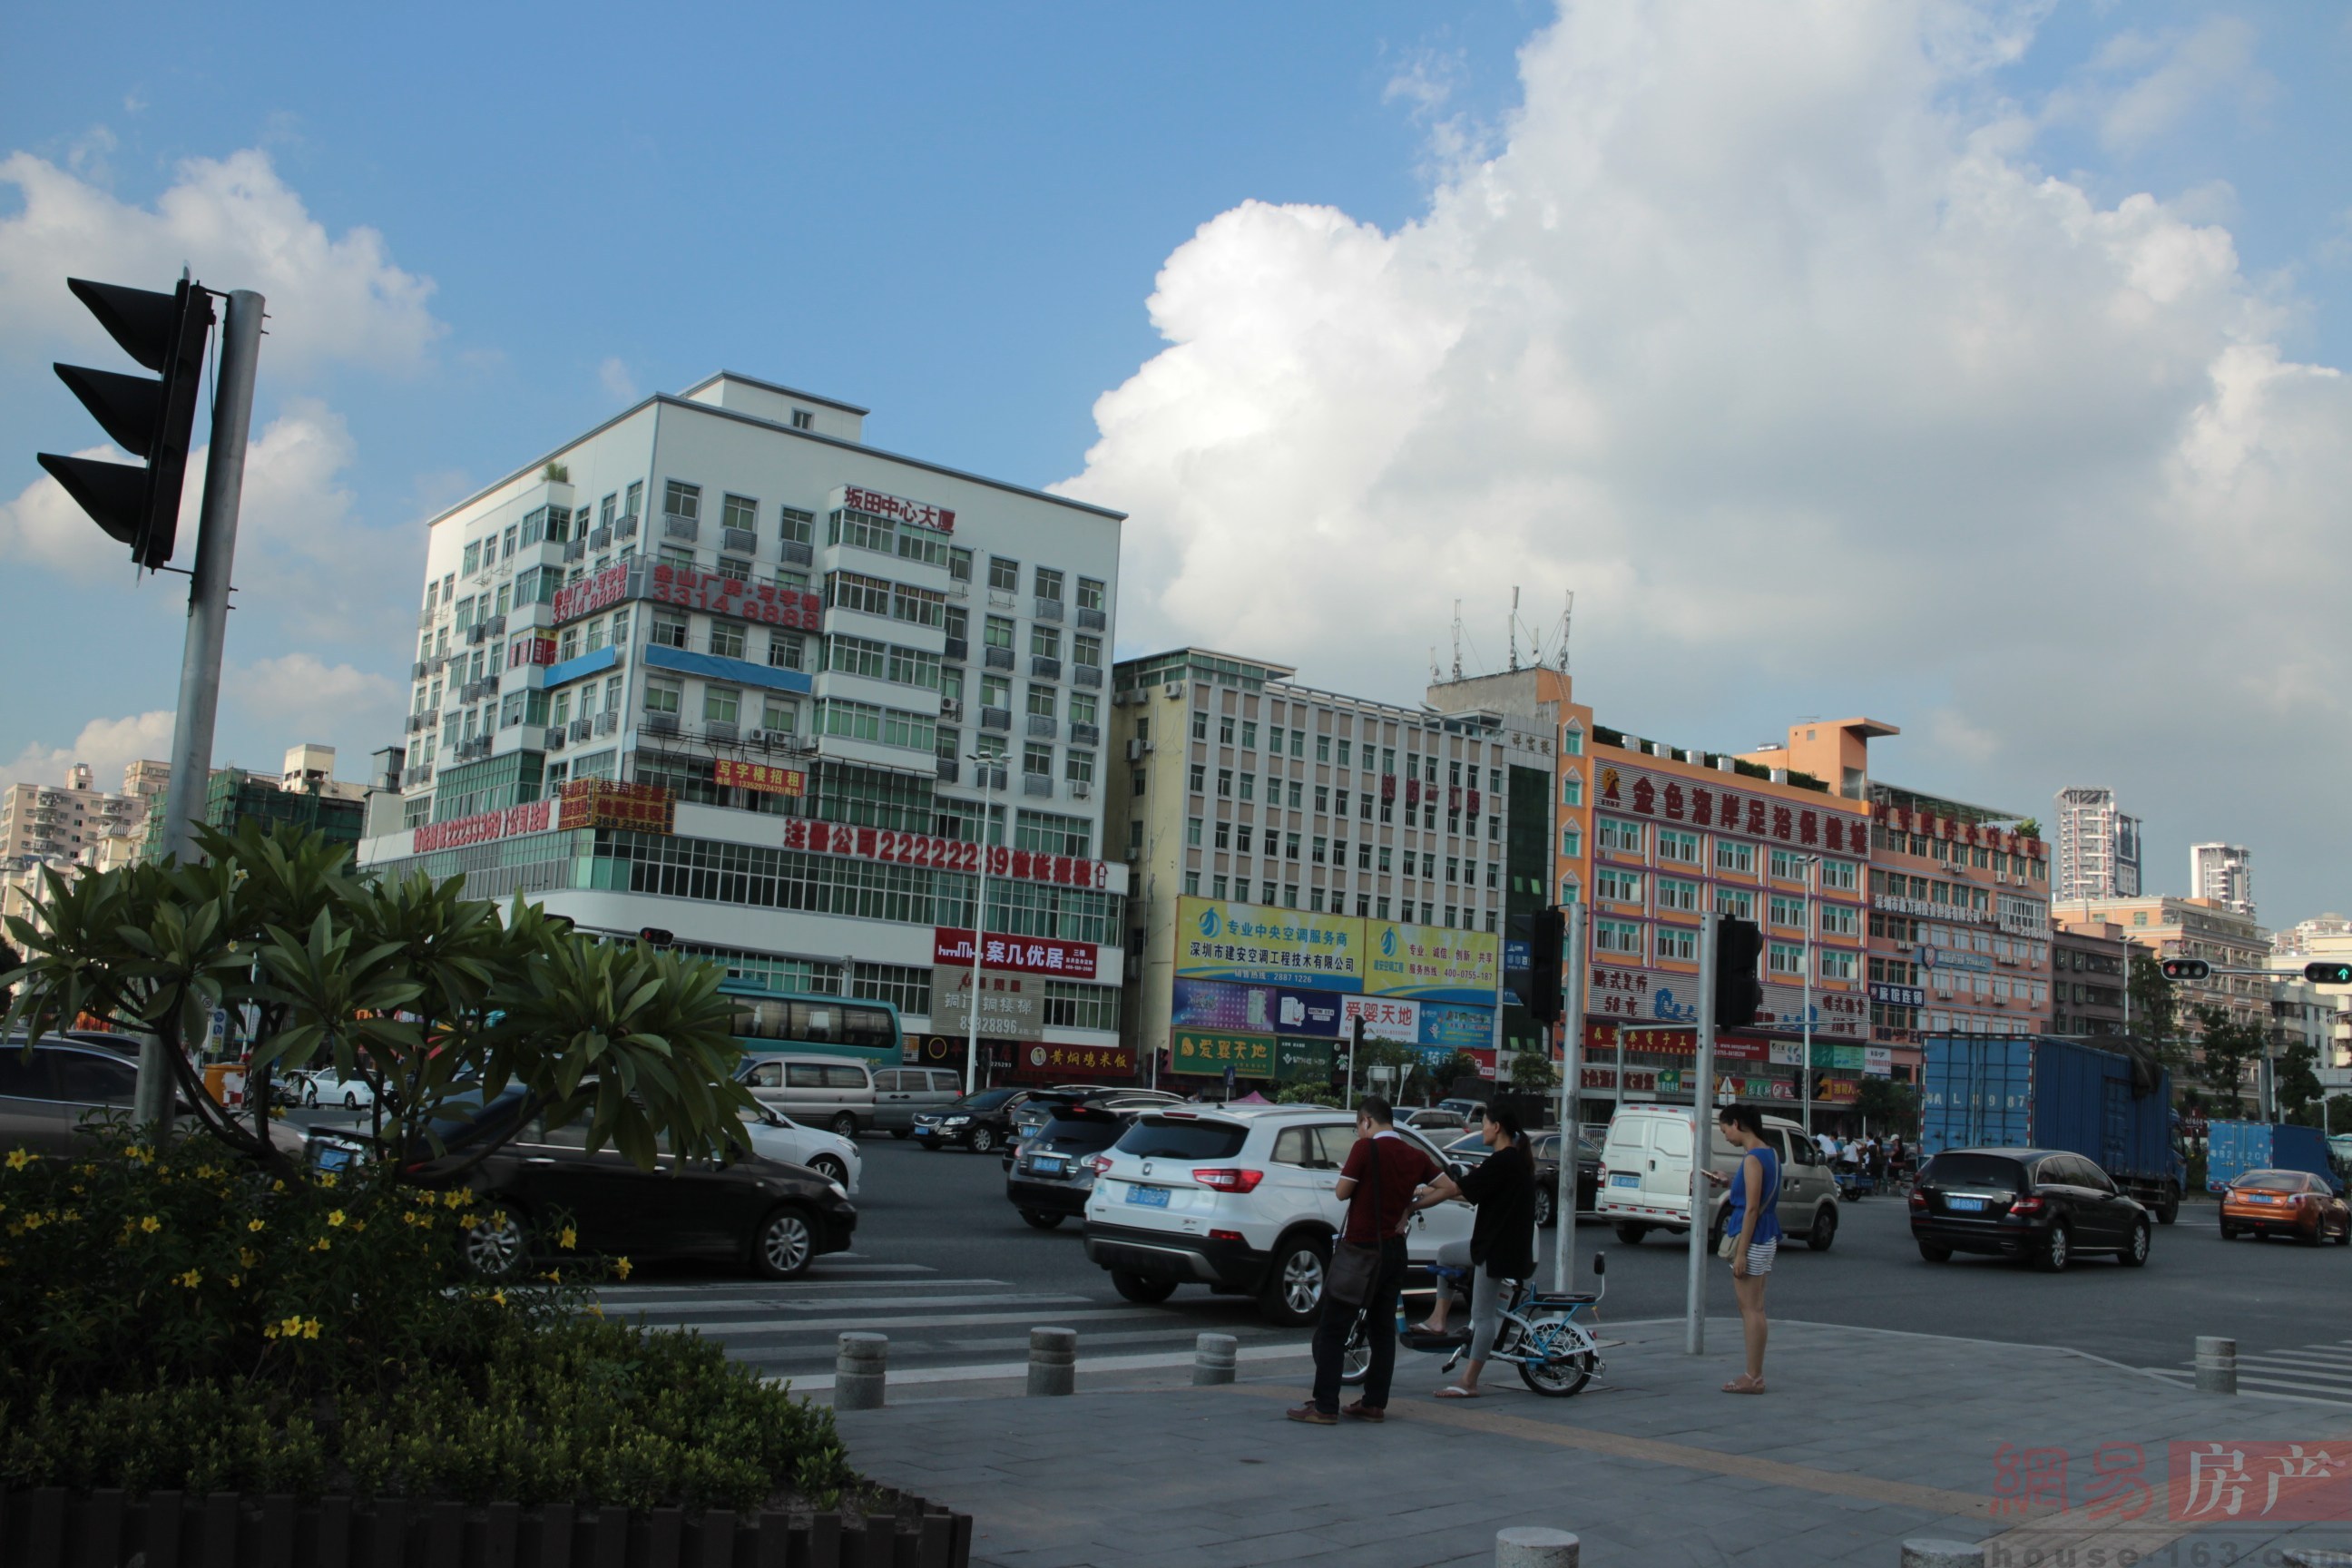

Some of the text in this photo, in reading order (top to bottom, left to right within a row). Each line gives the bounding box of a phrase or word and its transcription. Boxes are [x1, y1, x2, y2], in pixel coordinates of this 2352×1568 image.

[844, 486, 956, 533] 坂田中心大厦
[552, 582, 626, 624] 3314 8888
[652, 583, 818, 631] 3314 8888
[719, 760, 799, 787] 写字楼招租
[1227, 919, 1348, 946] 专业中央空调服务商
[985, 940, 1064, 970] 案几优居
[1190, 941, 1355, 973] 深圳市建安空调工程技术有限公司
[1274, 972, 1292, 982] 2887
[1294, 973, 1312, 984] 1226
[1444, 968, 1493, 981] 400-0755-187
[1879, 987, 1924, 1005] 旅馆连锁
[1345, 1001, 1413, 1026] 爱婴天地
[1050, 1048, 1128, 1069] 黄焖鸡米饭
[1199, 1038, 1269, 1060] 爱婴天地
